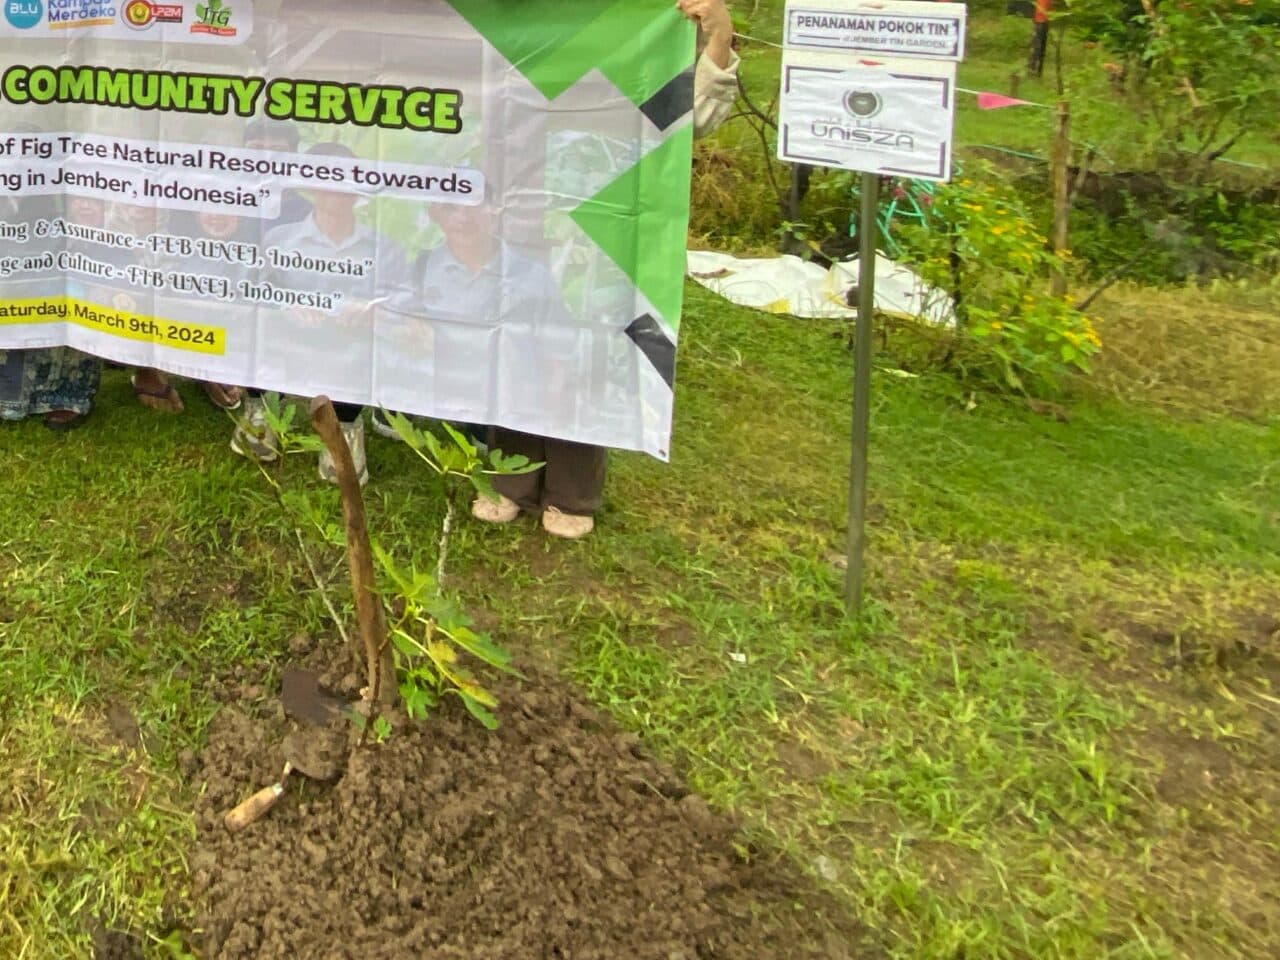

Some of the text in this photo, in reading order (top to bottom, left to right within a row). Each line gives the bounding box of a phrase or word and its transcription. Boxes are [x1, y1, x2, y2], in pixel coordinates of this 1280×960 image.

[48, 6, 116, 22] Merdeka
[797, 15, 949, 36] PENANAMAN POKOK TIN
[2, 66, 263, 117] COMMUNITY
[265, 79, 463, 132] SERVICE
[21, 138, 52, 159] Fig
[57, 137, 107, 158] Tree
[113, 142, 202, 168] Natural
[209, 151, 345, 183] Resources
[352, 164, 473, 194] towards
[26, 168, 45, 186] in
[51, 167, 138, 199] Jember,
[143, 178, 270, 208] Indonesia”
[35, 221, 48, 236] &
[50, 219, 133, 249] Assurance
[148, 235, 192, 256] FEB
[195, 240, 265, 267] UNEJ,
[269, 249, 373, 277] Indonesia”
[23, 254, 53, 270] and
[58, 253, 114, 278] Culture
[128, 266, 165, 288] FIB
[168, 273, 234, 301] UNEJ,
[238, 281, 342, 310] Indonesia”
[74, 304, 125, 330] March
[129, 318, 164, 340] 9th,
[167, 325, 216, 346] 2024
